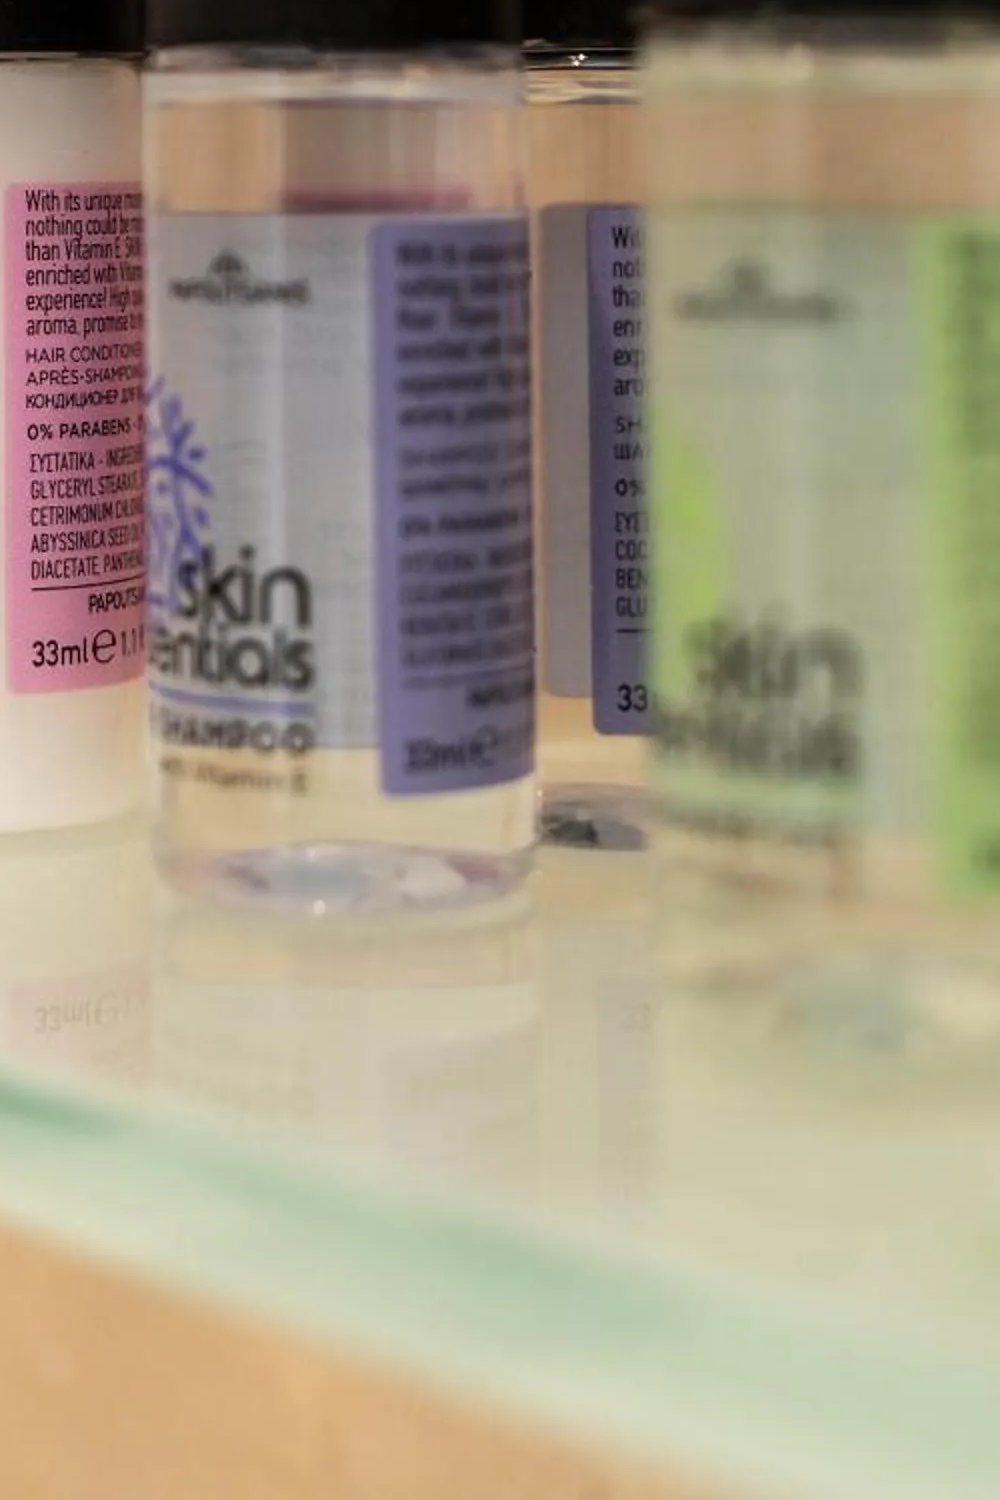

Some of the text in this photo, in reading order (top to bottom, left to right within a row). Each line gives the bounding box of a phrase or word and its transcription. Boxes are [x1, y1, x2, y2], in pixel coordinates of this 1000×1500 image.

[25, 189, 60, 212] With
[64, 192, 81, 211] its
[25, 214, 83, 239] nothing
[25, 240, 61, 261] than
[65, 238, 113, 261] Vitamin
[25, 263, 91, 287] enriched
[25, 347, 66, 364] HAIR
[27, 423, 53, 442] 0%
[59, 419, 131, 439] PARABENS
[30, 476, 96, 500] GLYCERYL
[30, 530, 105, 553] ABYSSINICA
[30, 555, 99, 580] DIACETATE
[177, 544, 312, 628] skin
[32, 638, 88, 668] 33ml
[617, 682, 653, 712] 33
